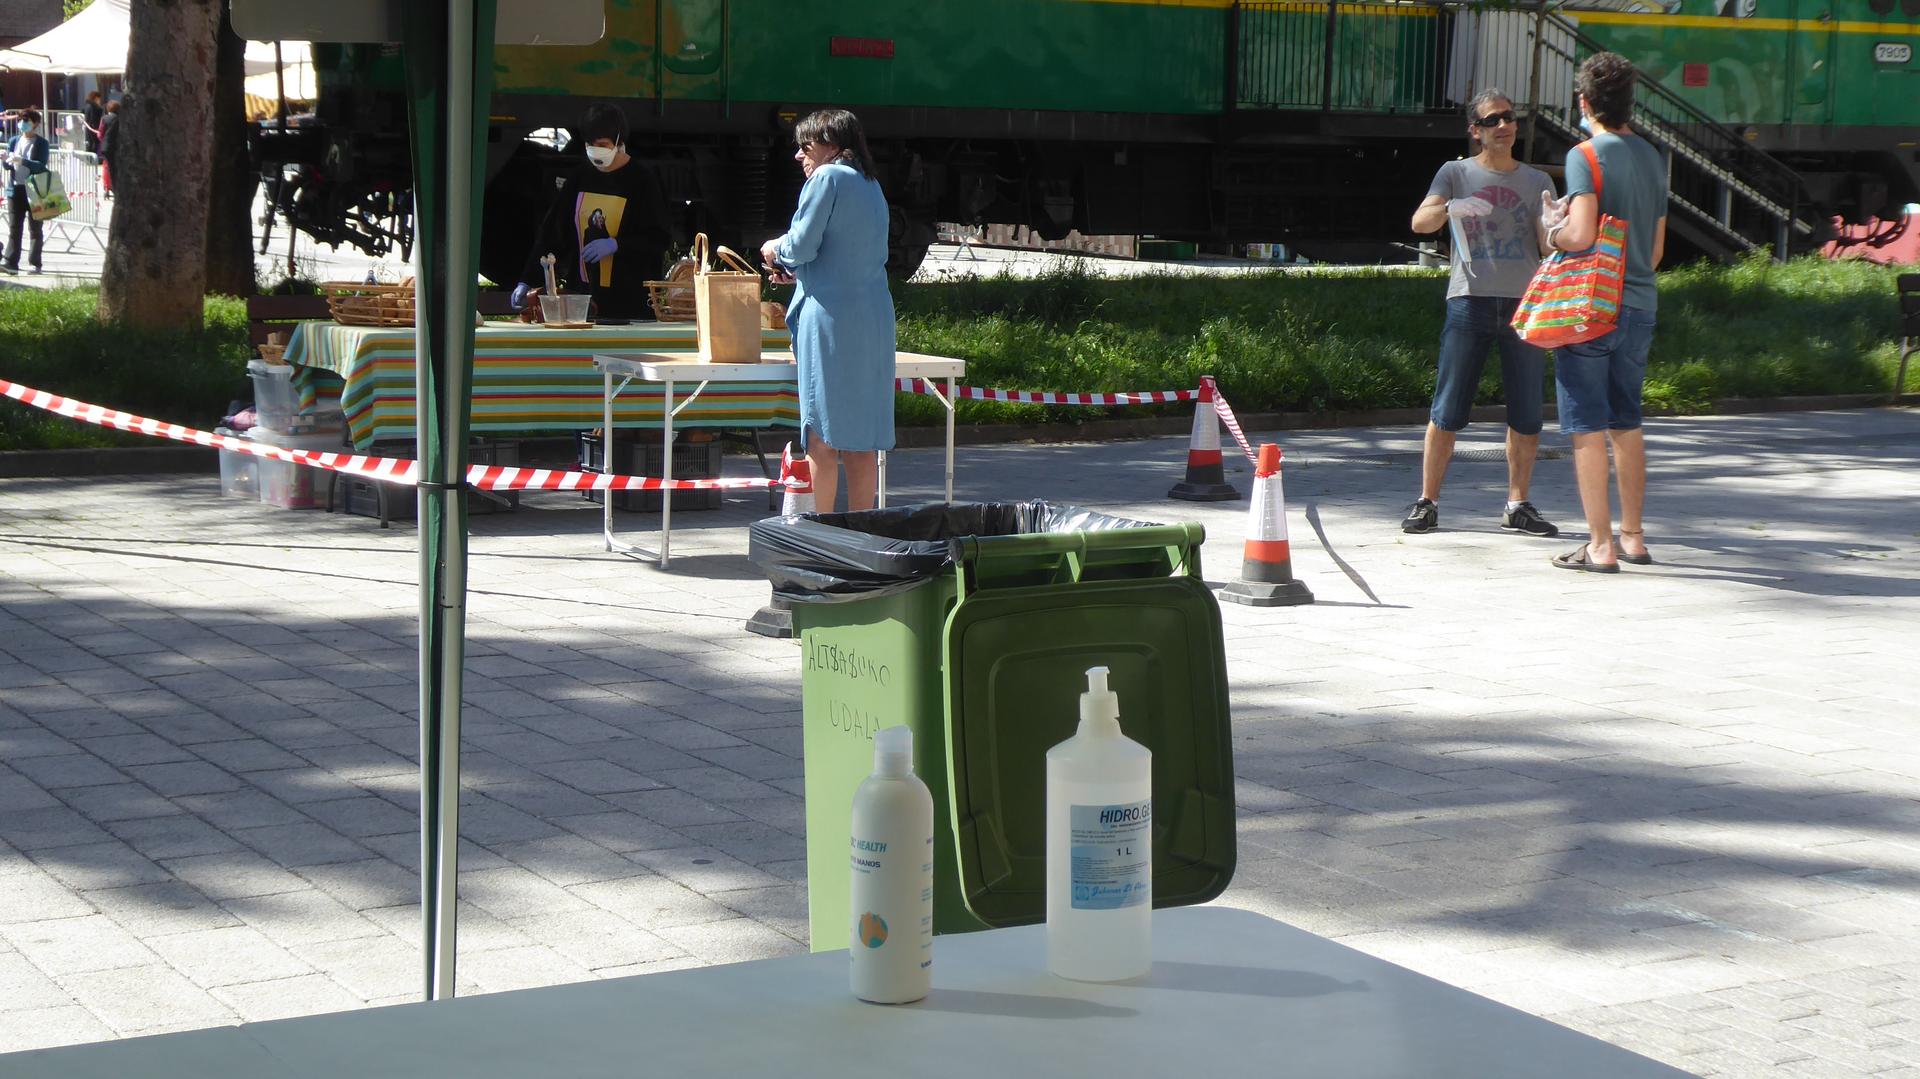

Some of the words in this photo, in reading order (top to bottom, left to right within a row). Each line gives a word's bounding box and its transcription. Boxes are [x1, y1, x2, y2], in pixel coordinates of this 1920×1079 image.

[857, 839, 888, 853] HEALTH
[1117, 848, 1121, 856] 1
[1126, 847, 1133, 855] L
[857, 857, 881, 868] MANOS
